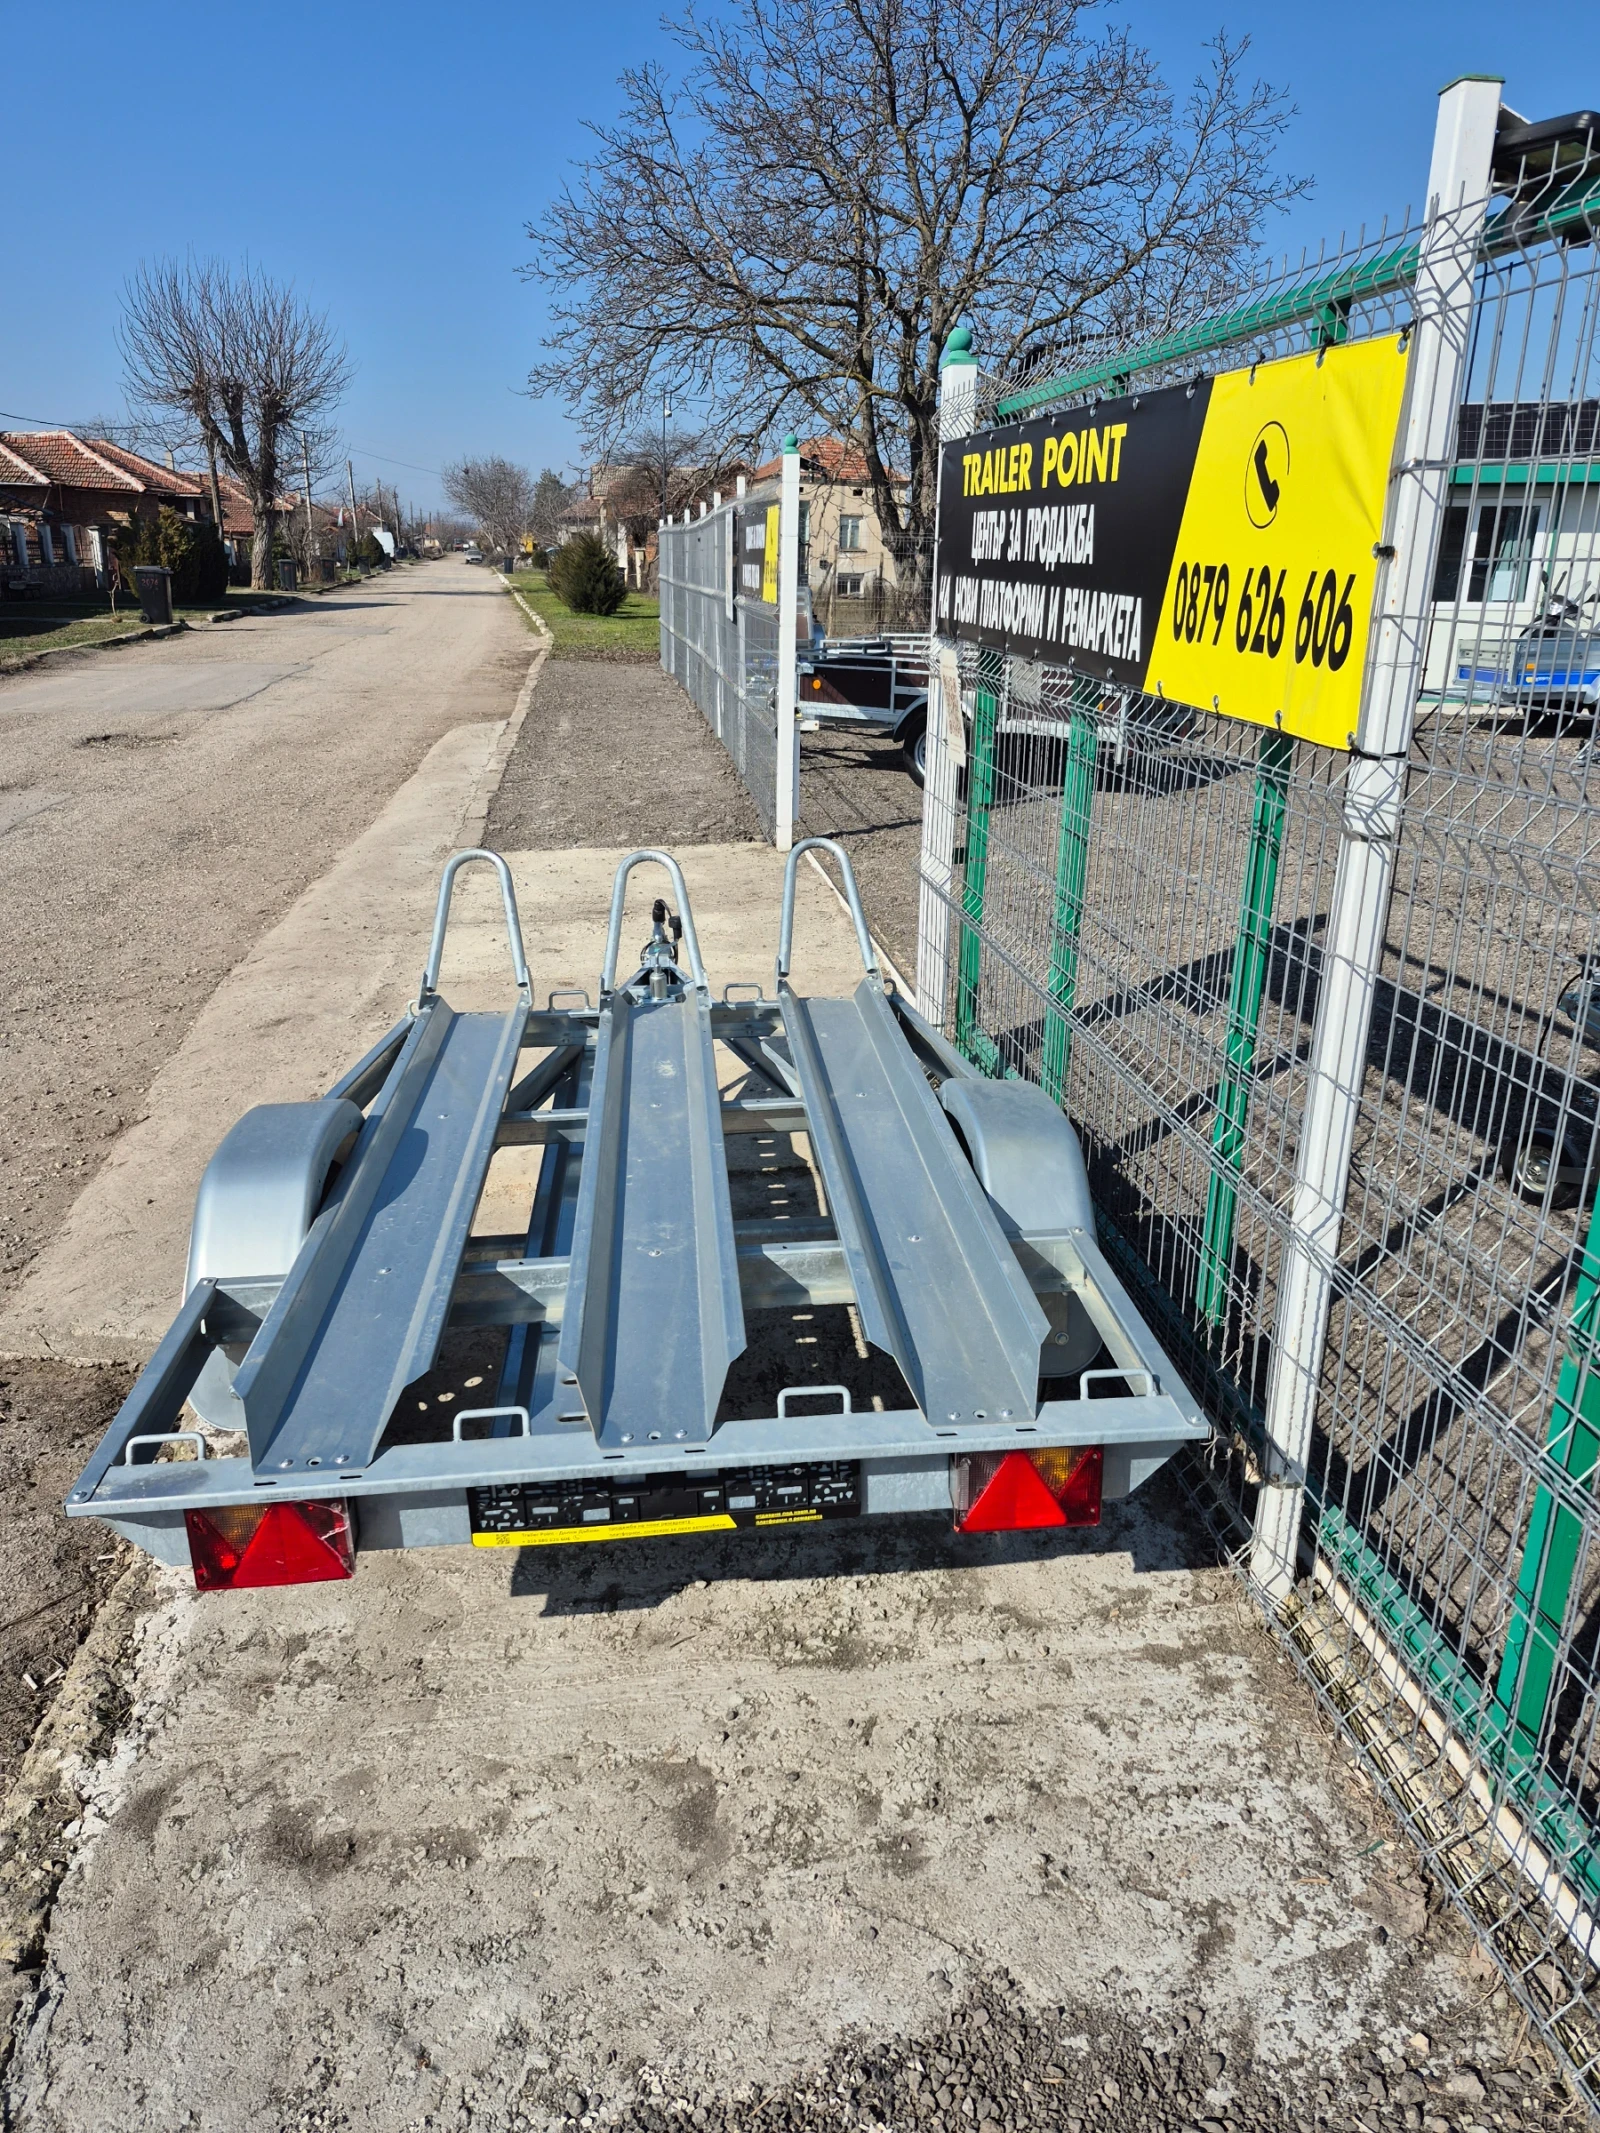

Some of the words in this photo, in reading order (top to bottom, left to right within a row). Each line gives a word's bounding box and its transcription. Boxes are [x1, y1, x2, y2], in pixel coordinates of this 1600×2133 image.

[962, 442, 1033, 497] TRAILER
[1041, 423, 1128, 489] POINT
[971, 510, 1006, 566] ЦЕНТЪР
[1007, 508, 1021, 562] ЗА
[1024, 504, 1095, 571] ПРОДАЖБА
[937, 575, 951, 619] НА
[953, 576, 979, 625] НОВИ
[979, 579, 1046, 639] ПЛАТФОРМИ
[1046, 586, 1061, 642] И
[1061, 587, 1142, 663] РЕМАРКЕТА
[1173, 561, 1230, 646] 0879
[1235, 565, 1288, 659] 626
[1294, 568, 1357, 672] 606
